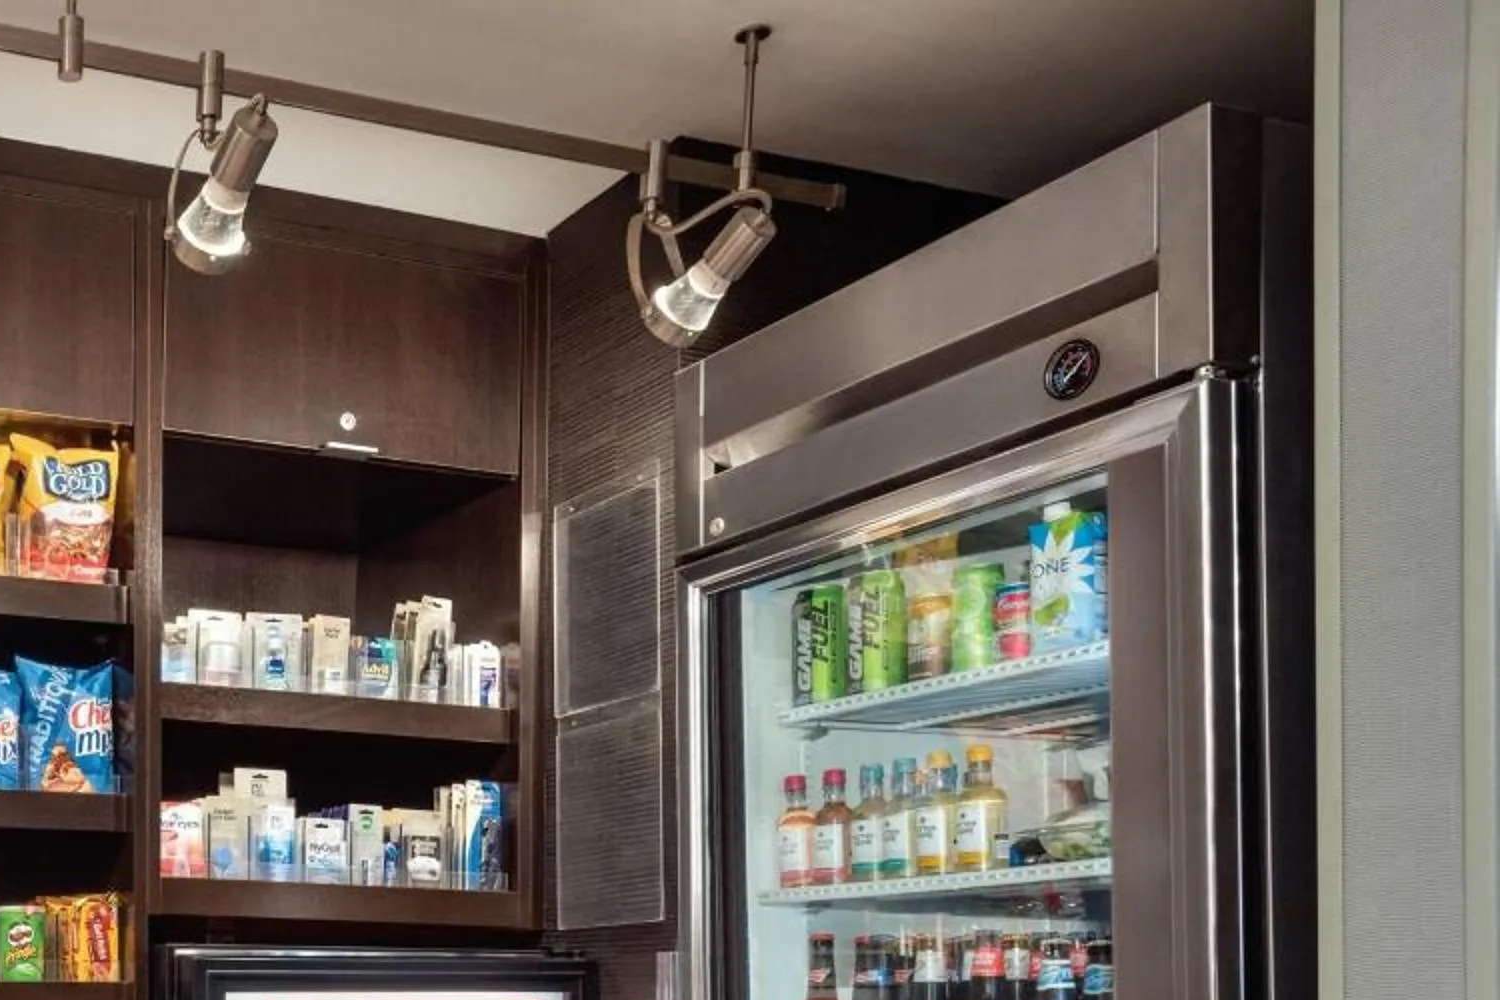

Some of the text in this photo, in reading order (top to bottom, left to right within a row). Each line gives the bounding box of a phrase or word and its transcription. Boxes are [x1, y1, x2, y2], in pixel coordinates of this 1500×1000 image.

[51, 473, 106, 500] GOLD
[1031, 557, 1071, 578] ONE
[811, 602, 829, 662] FUEL
[861, 586, 880, 649] FUEL
[70, 699, 112, 731] Che
[77, 729, 112, 757] mi
